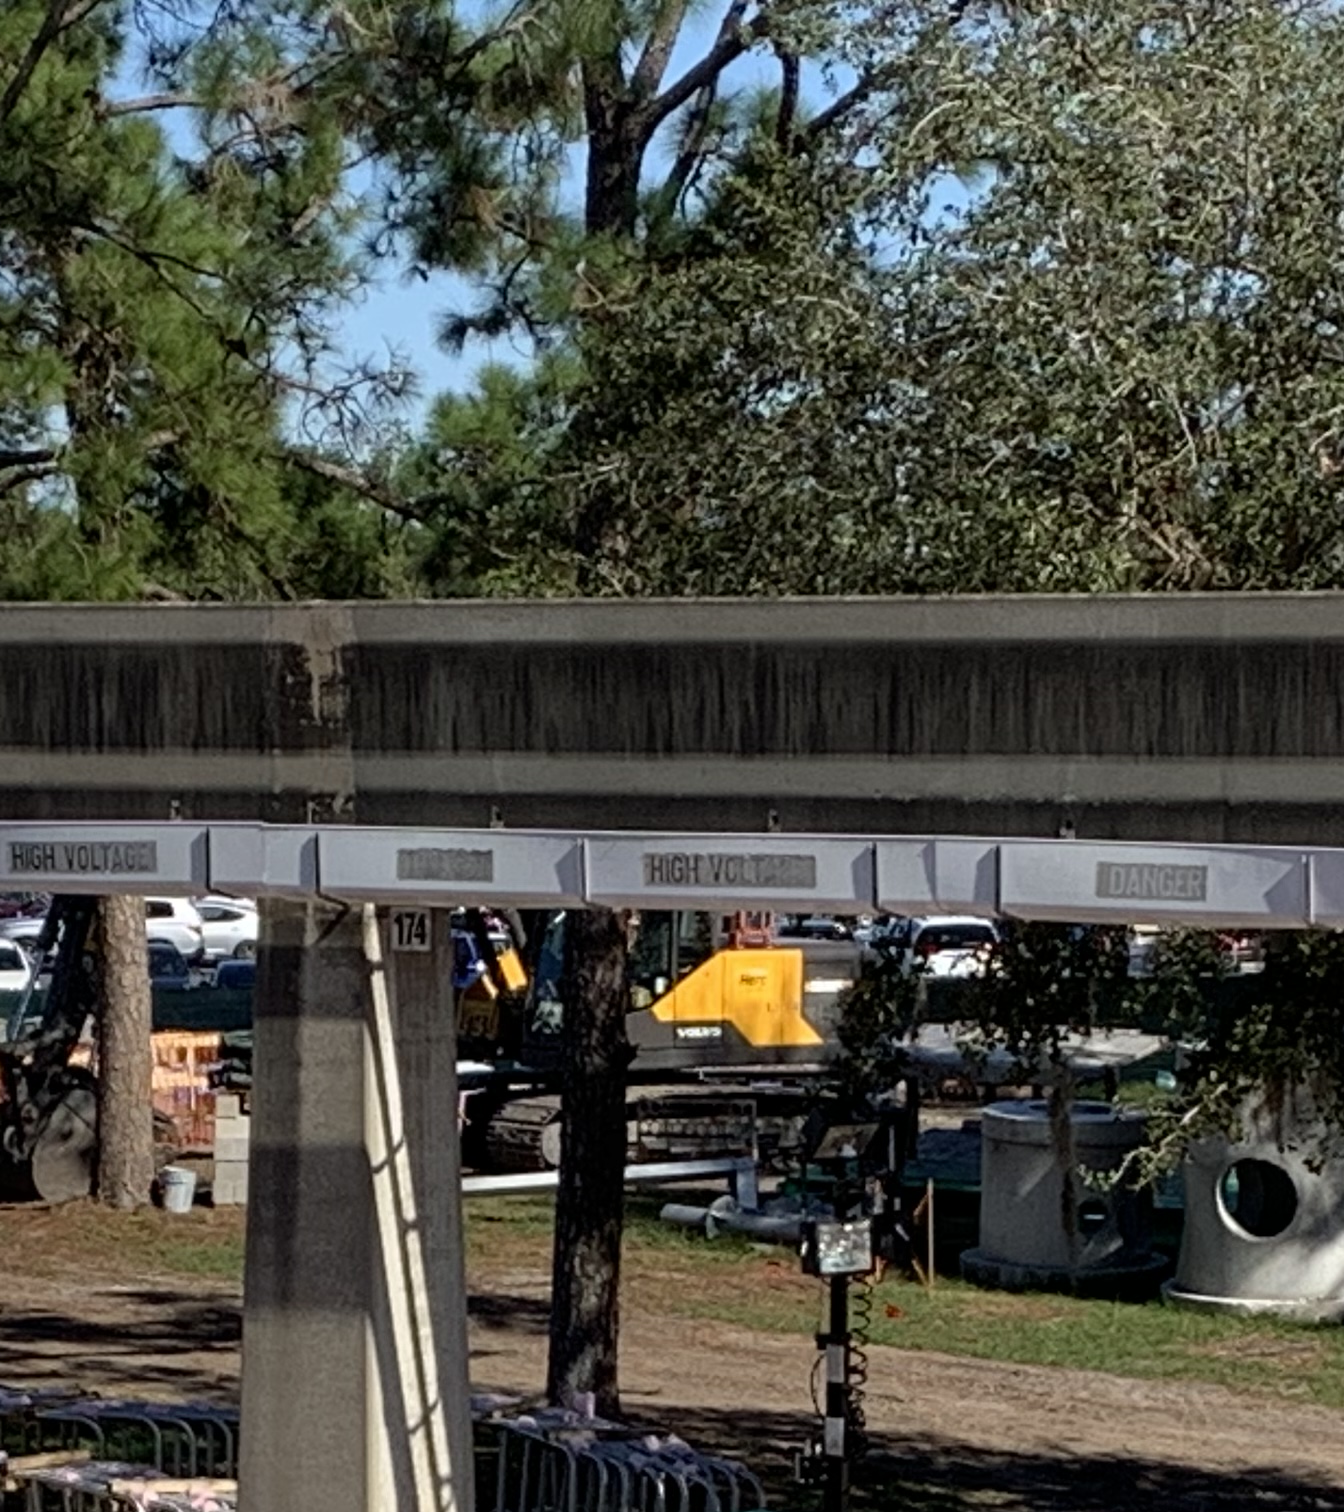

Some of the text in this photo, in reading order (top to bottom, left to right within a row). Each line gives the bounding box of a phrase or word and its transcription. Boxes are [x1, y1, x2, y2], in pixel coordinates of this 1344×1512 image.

[12, 845, 149, 871] HIGH VOLTAGE
[651, 855, 699, 884] HIGH
[1109, 866, 1202, 897] DANGER
[394, 912, 426, 945] 174
[676, 1026, 722, 1038] VOLVO
